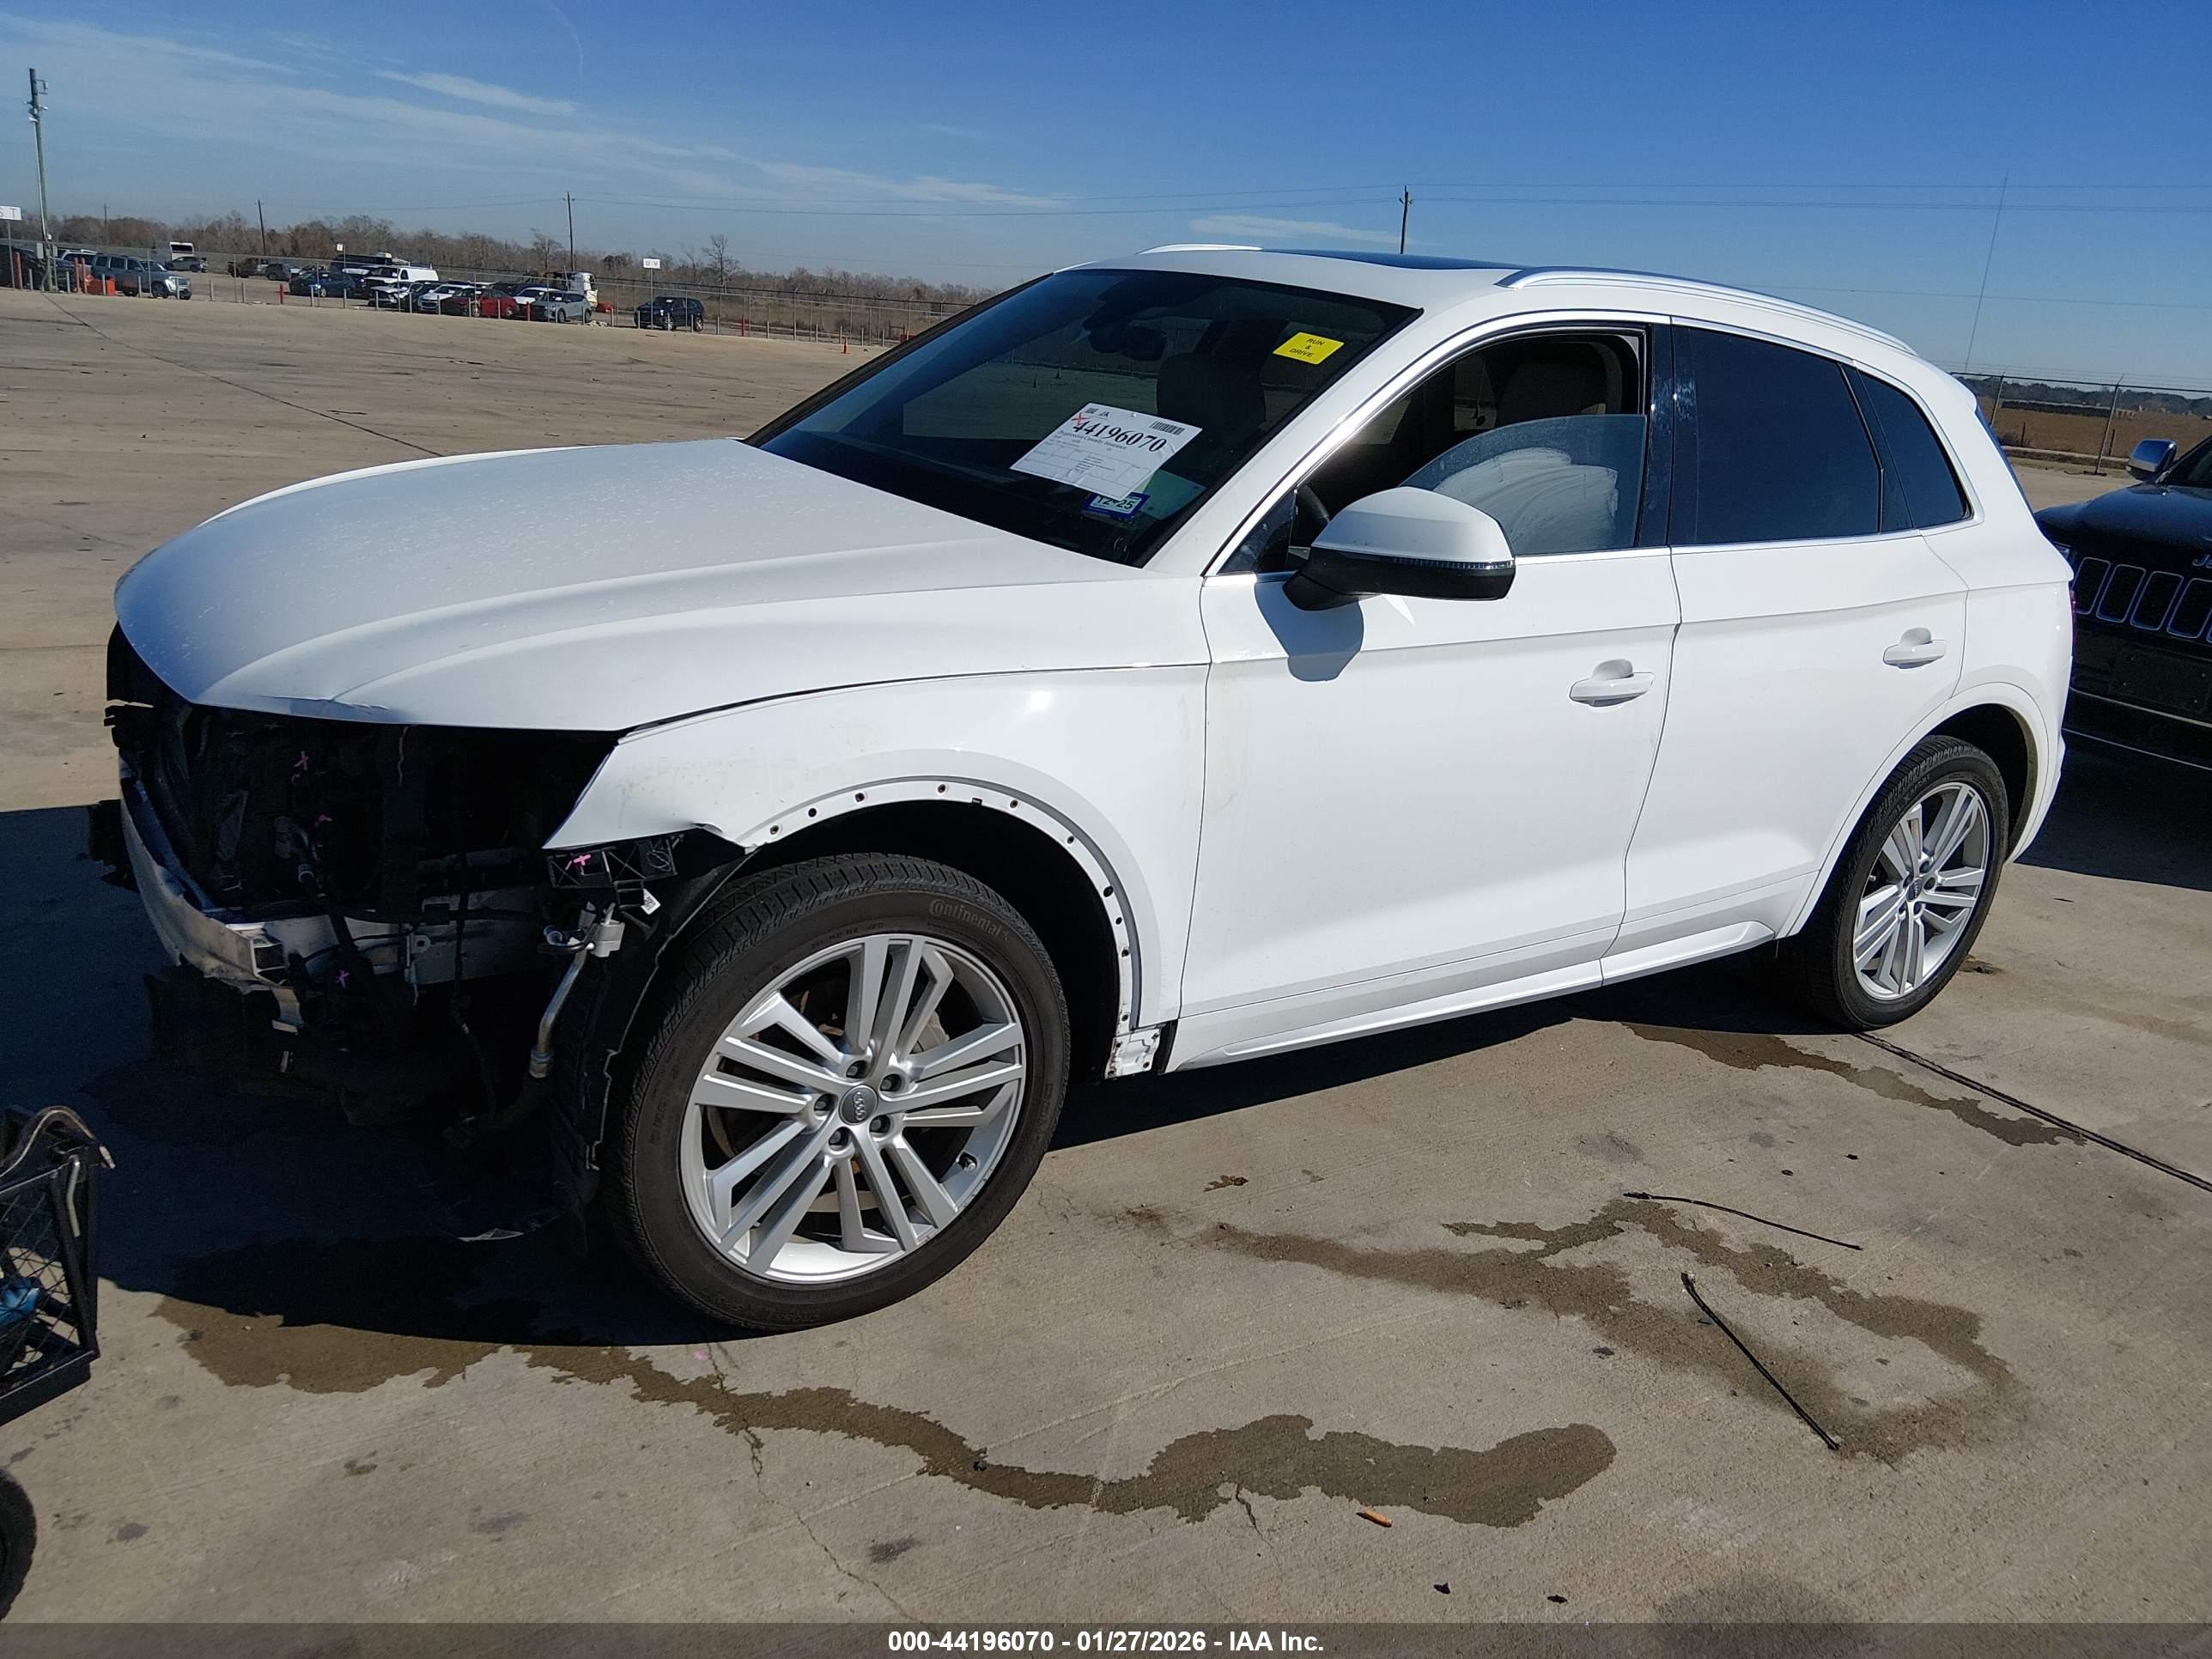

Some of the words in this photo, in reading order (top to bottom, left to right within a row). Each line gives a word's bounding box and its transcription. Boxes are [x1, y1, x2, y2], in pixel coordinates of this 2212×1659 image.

[1290, 348, 1314, 357] DRIVE
[1073, 421, 1168, 453] 44196070
[1115, 498, 1135, 509] 25
[929, 899, 1002, 937] Continental
